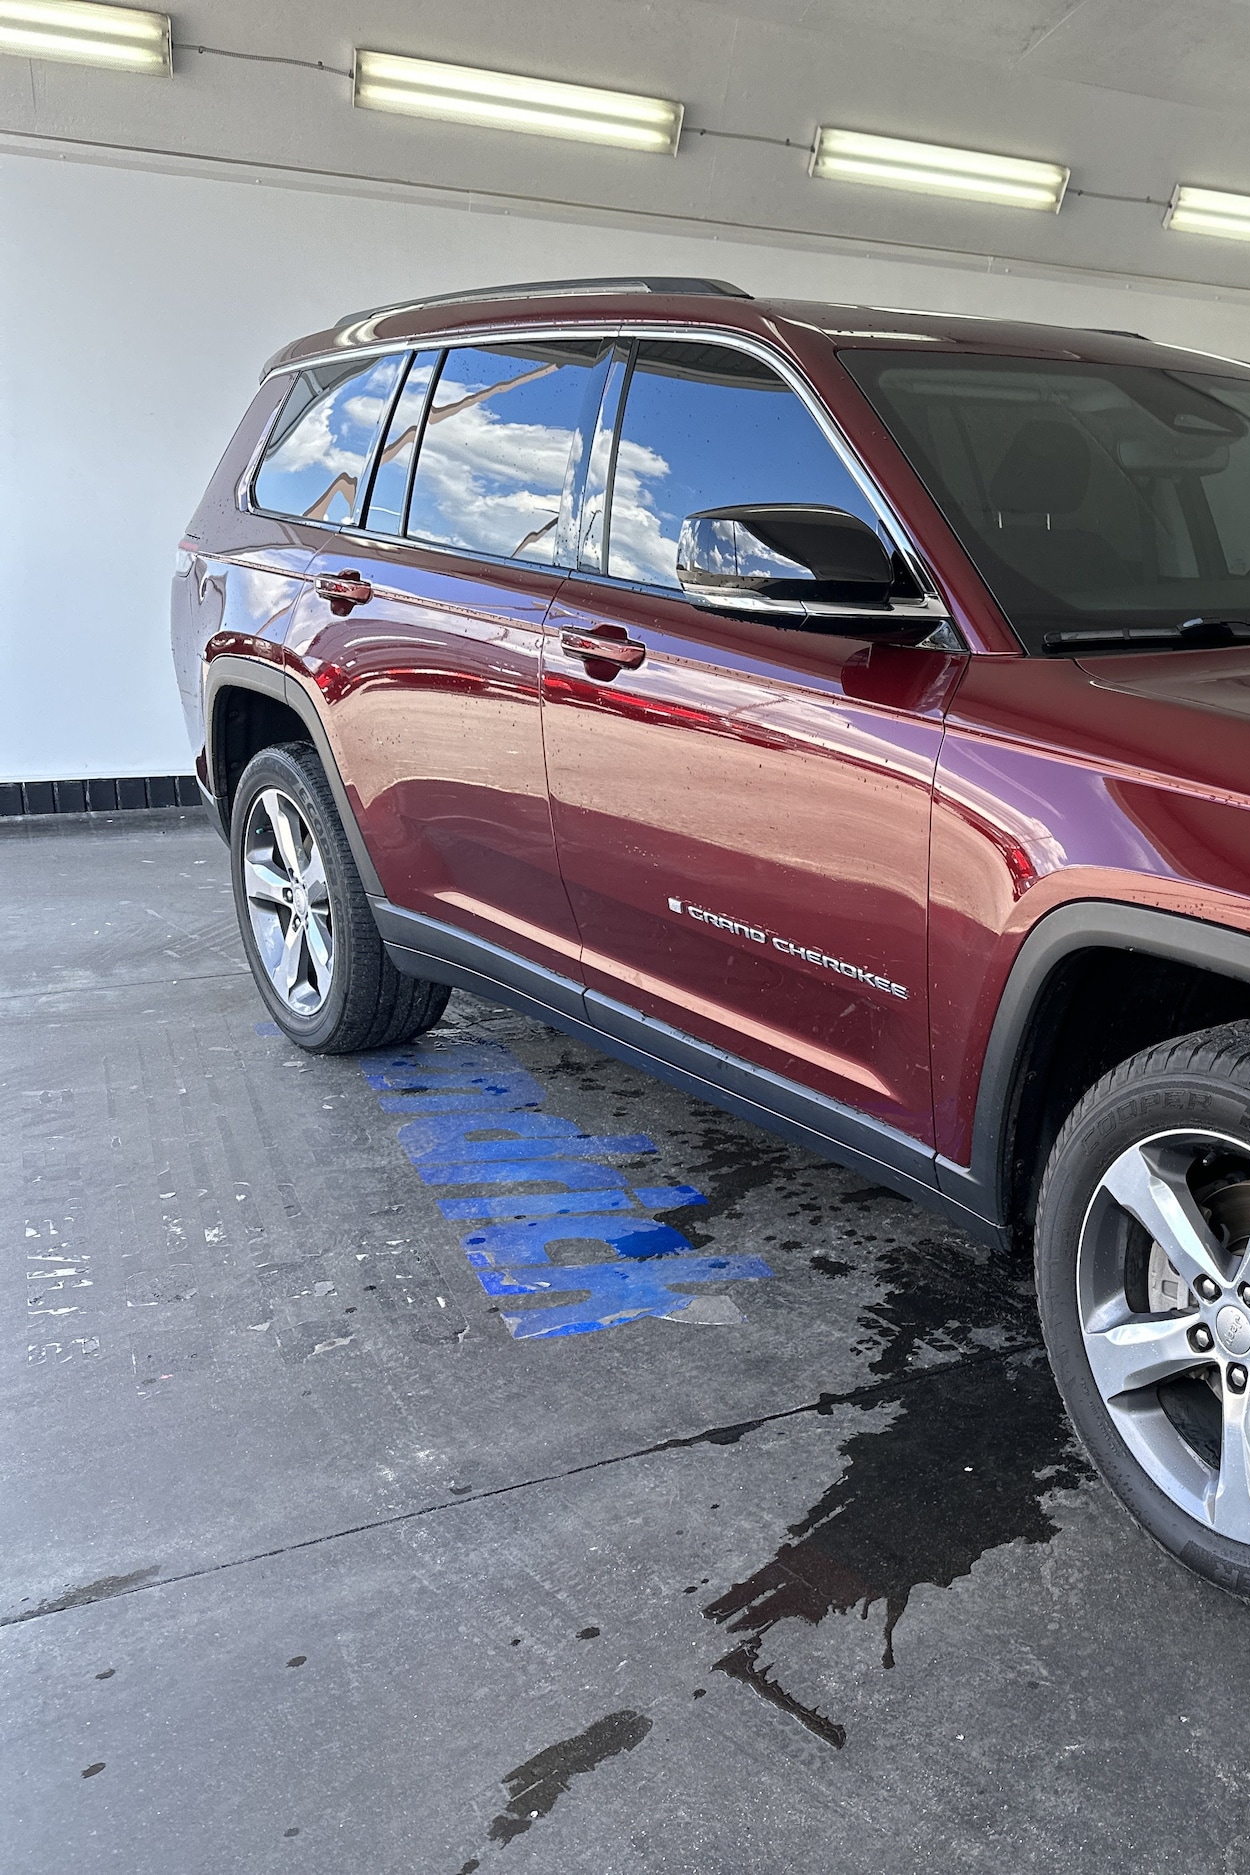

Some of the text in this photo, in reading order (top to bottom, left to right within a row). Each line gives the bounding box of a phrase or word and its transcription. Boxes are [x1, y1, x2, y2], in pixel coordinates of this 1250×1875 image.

[687, 905, 910, 1000] GRAND CHEROKEE
[1082, 1088, 1213, 1156] COOPER
